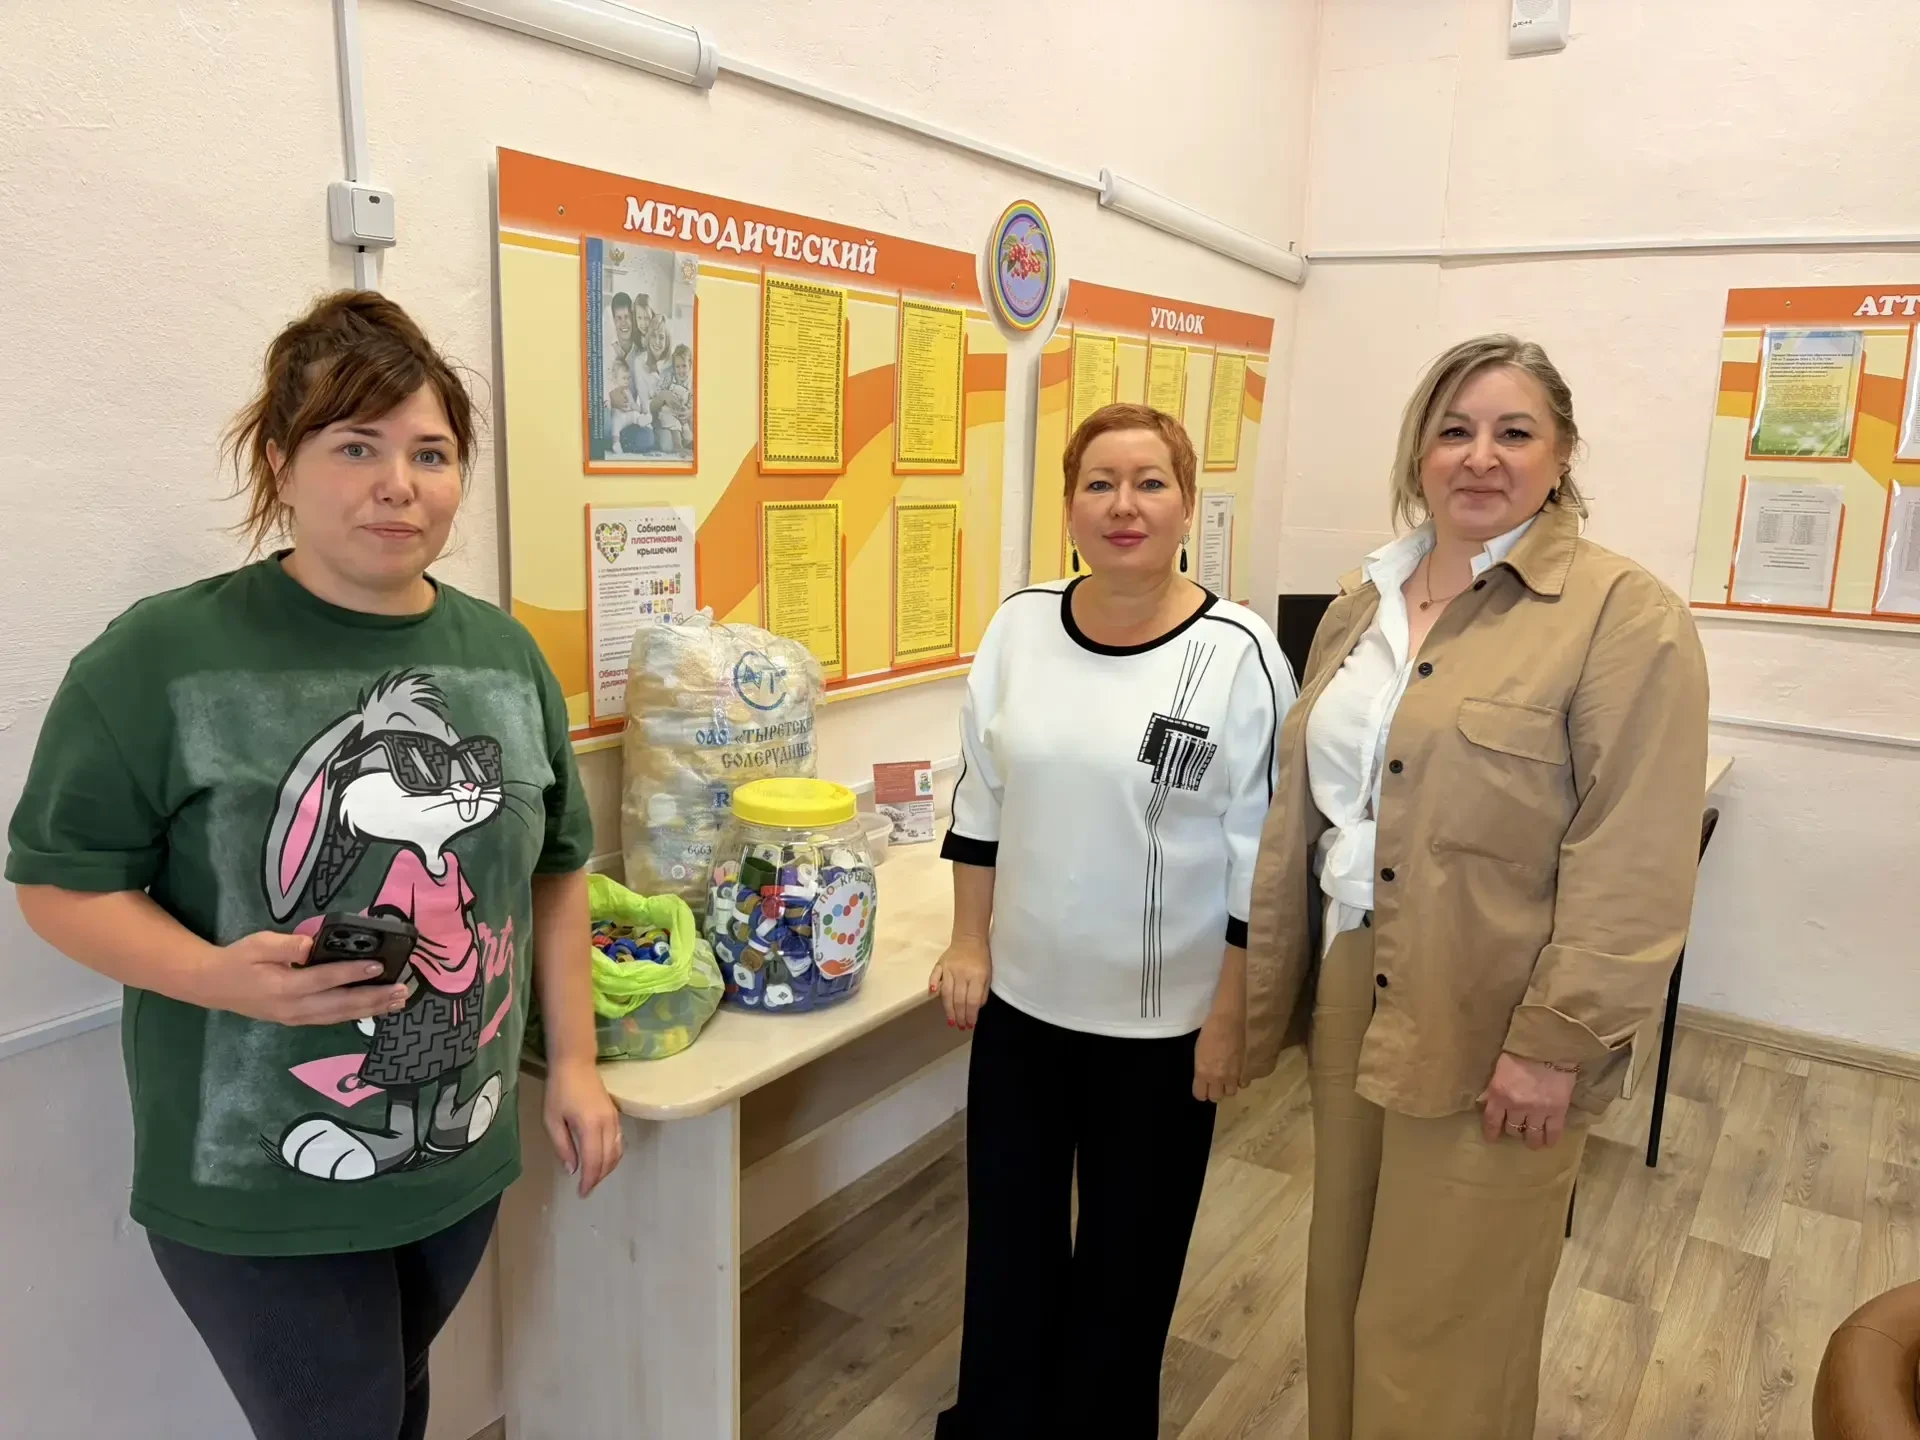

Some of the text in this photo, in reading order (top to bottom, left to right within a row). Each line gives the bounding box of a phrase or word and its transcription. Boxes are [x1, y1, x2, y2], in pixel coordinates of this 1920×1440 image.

[623, 195, 878, 275] МЕТОДИЧЕСКИЙ
[1852, 294, 1920, 317] АТТ
[1150, 306, 1205, 335] УГОЛОК
[636, 523, 677, 535] Собираем
[631, 535, 683, 545] пластиковые
[636, 546, 678, 557] крышечки
[819, 885, 835, 904] ПО
